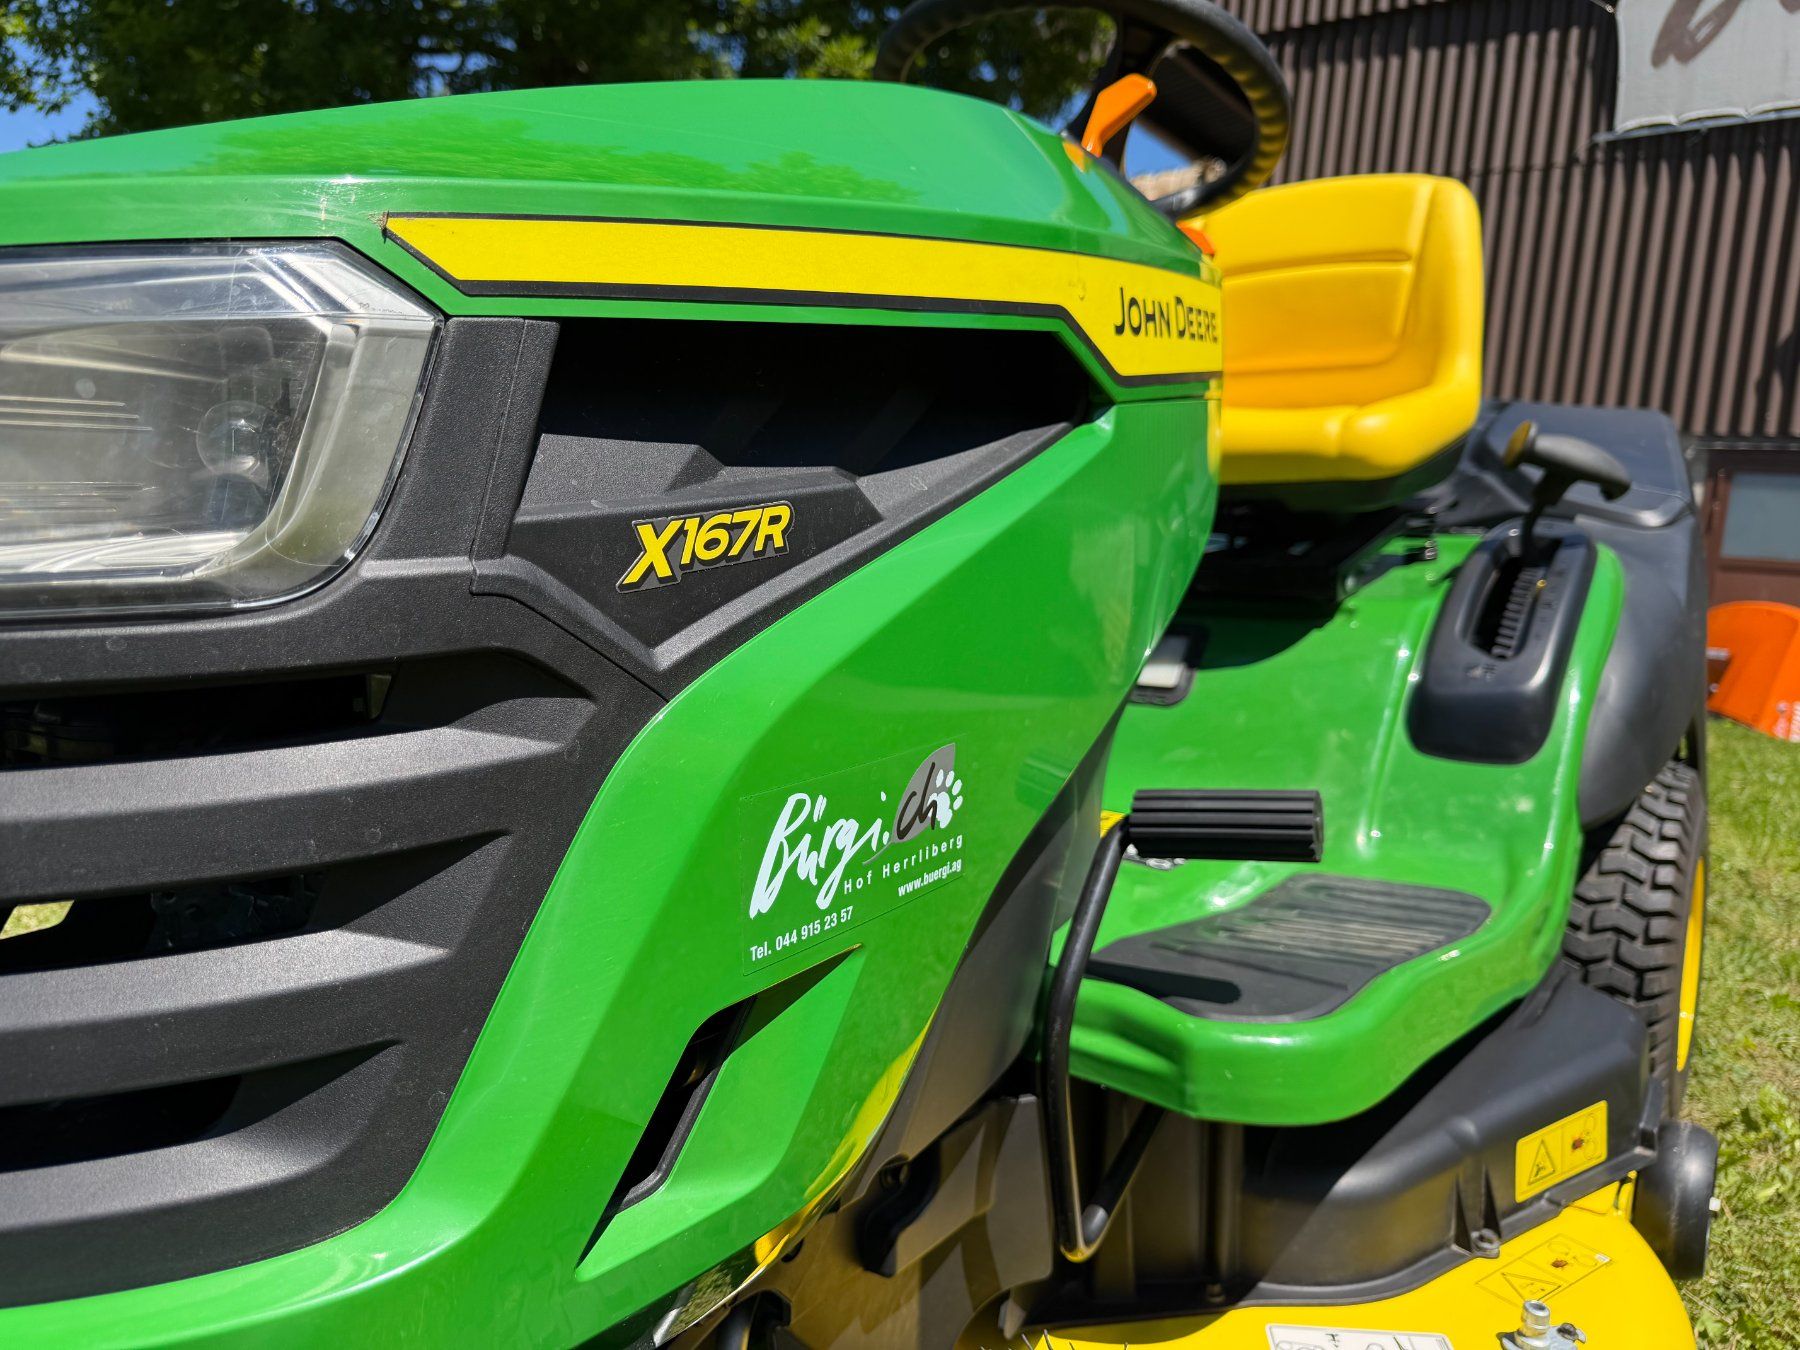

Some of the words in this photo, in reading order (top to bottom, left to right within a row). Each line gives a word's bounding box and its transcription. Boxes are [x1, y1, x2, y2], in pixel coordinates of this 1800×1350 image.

[1114, 286, 1171, 338] JOHN
[1174, 295, 1218, 344] DEERE
[622, 505, 791, 585] X167R
[844, 870, 873, 895] Hof
[882, 834, 963, 879] Herrliberg
[898, 858, 962, 897] www.buergi.ag
[750, 944, 772, 962] Tel.
[775, 929, 798, 951] 044
[801, 919, 821, 941] 915
[824, 911, 838, 931] 23
[840, 905, 854, 923] 57
